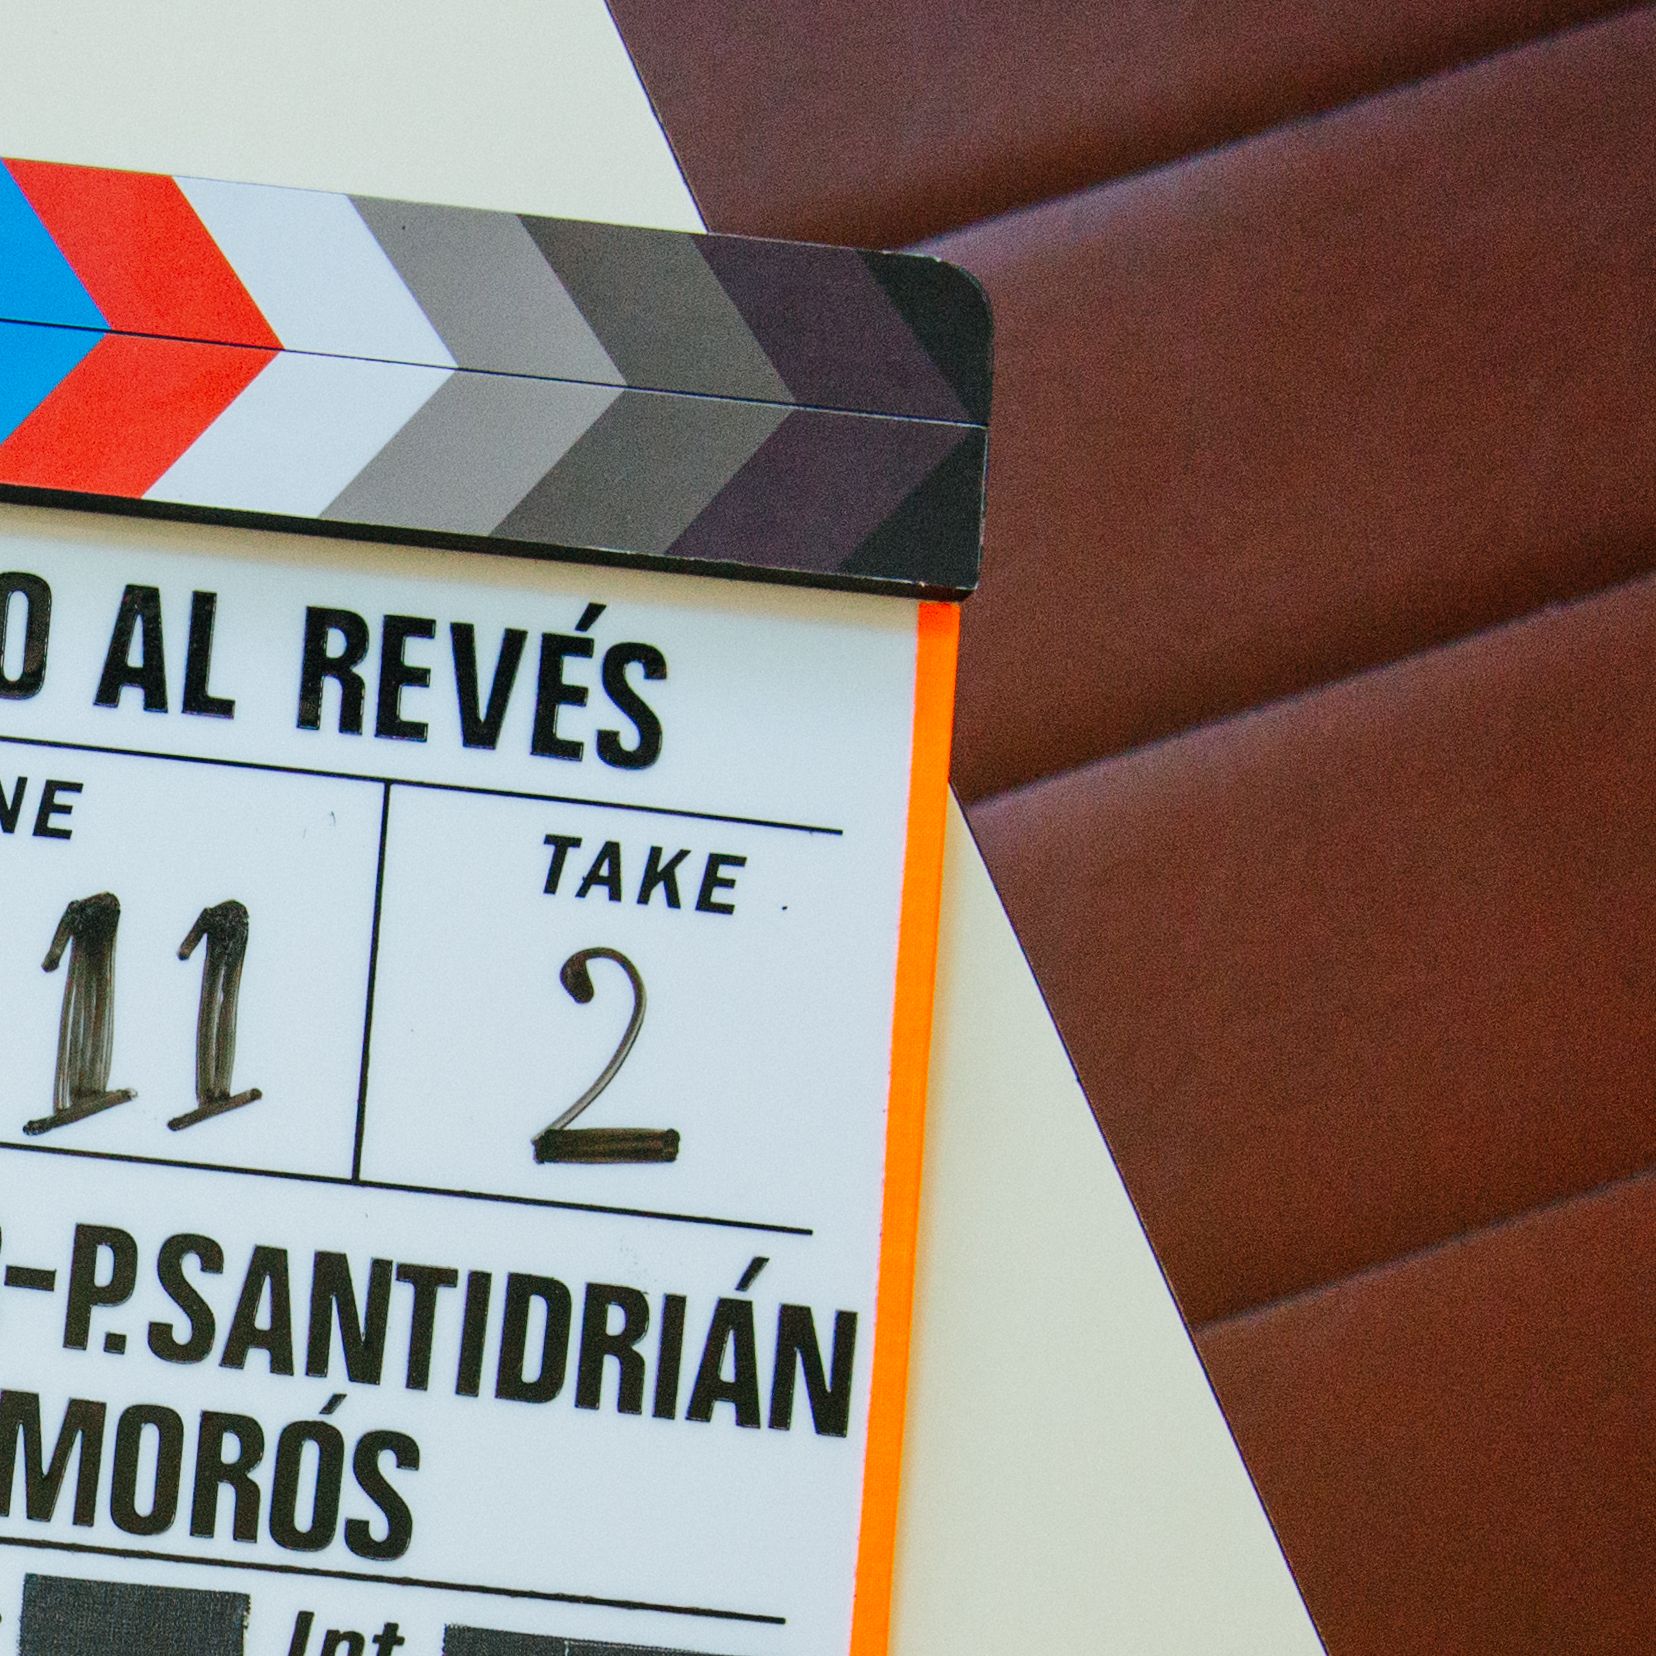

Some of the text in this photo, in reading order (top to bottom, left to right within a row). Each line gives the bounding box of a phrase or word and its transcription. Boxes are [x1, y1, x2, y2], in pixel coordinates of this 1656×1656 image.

[92, 583, 236, 721] AL
[295, 603, 669, 772] REVÉS
[542, 835, 748, 916] TAKE
[532, 946, 681, 1165] 2
